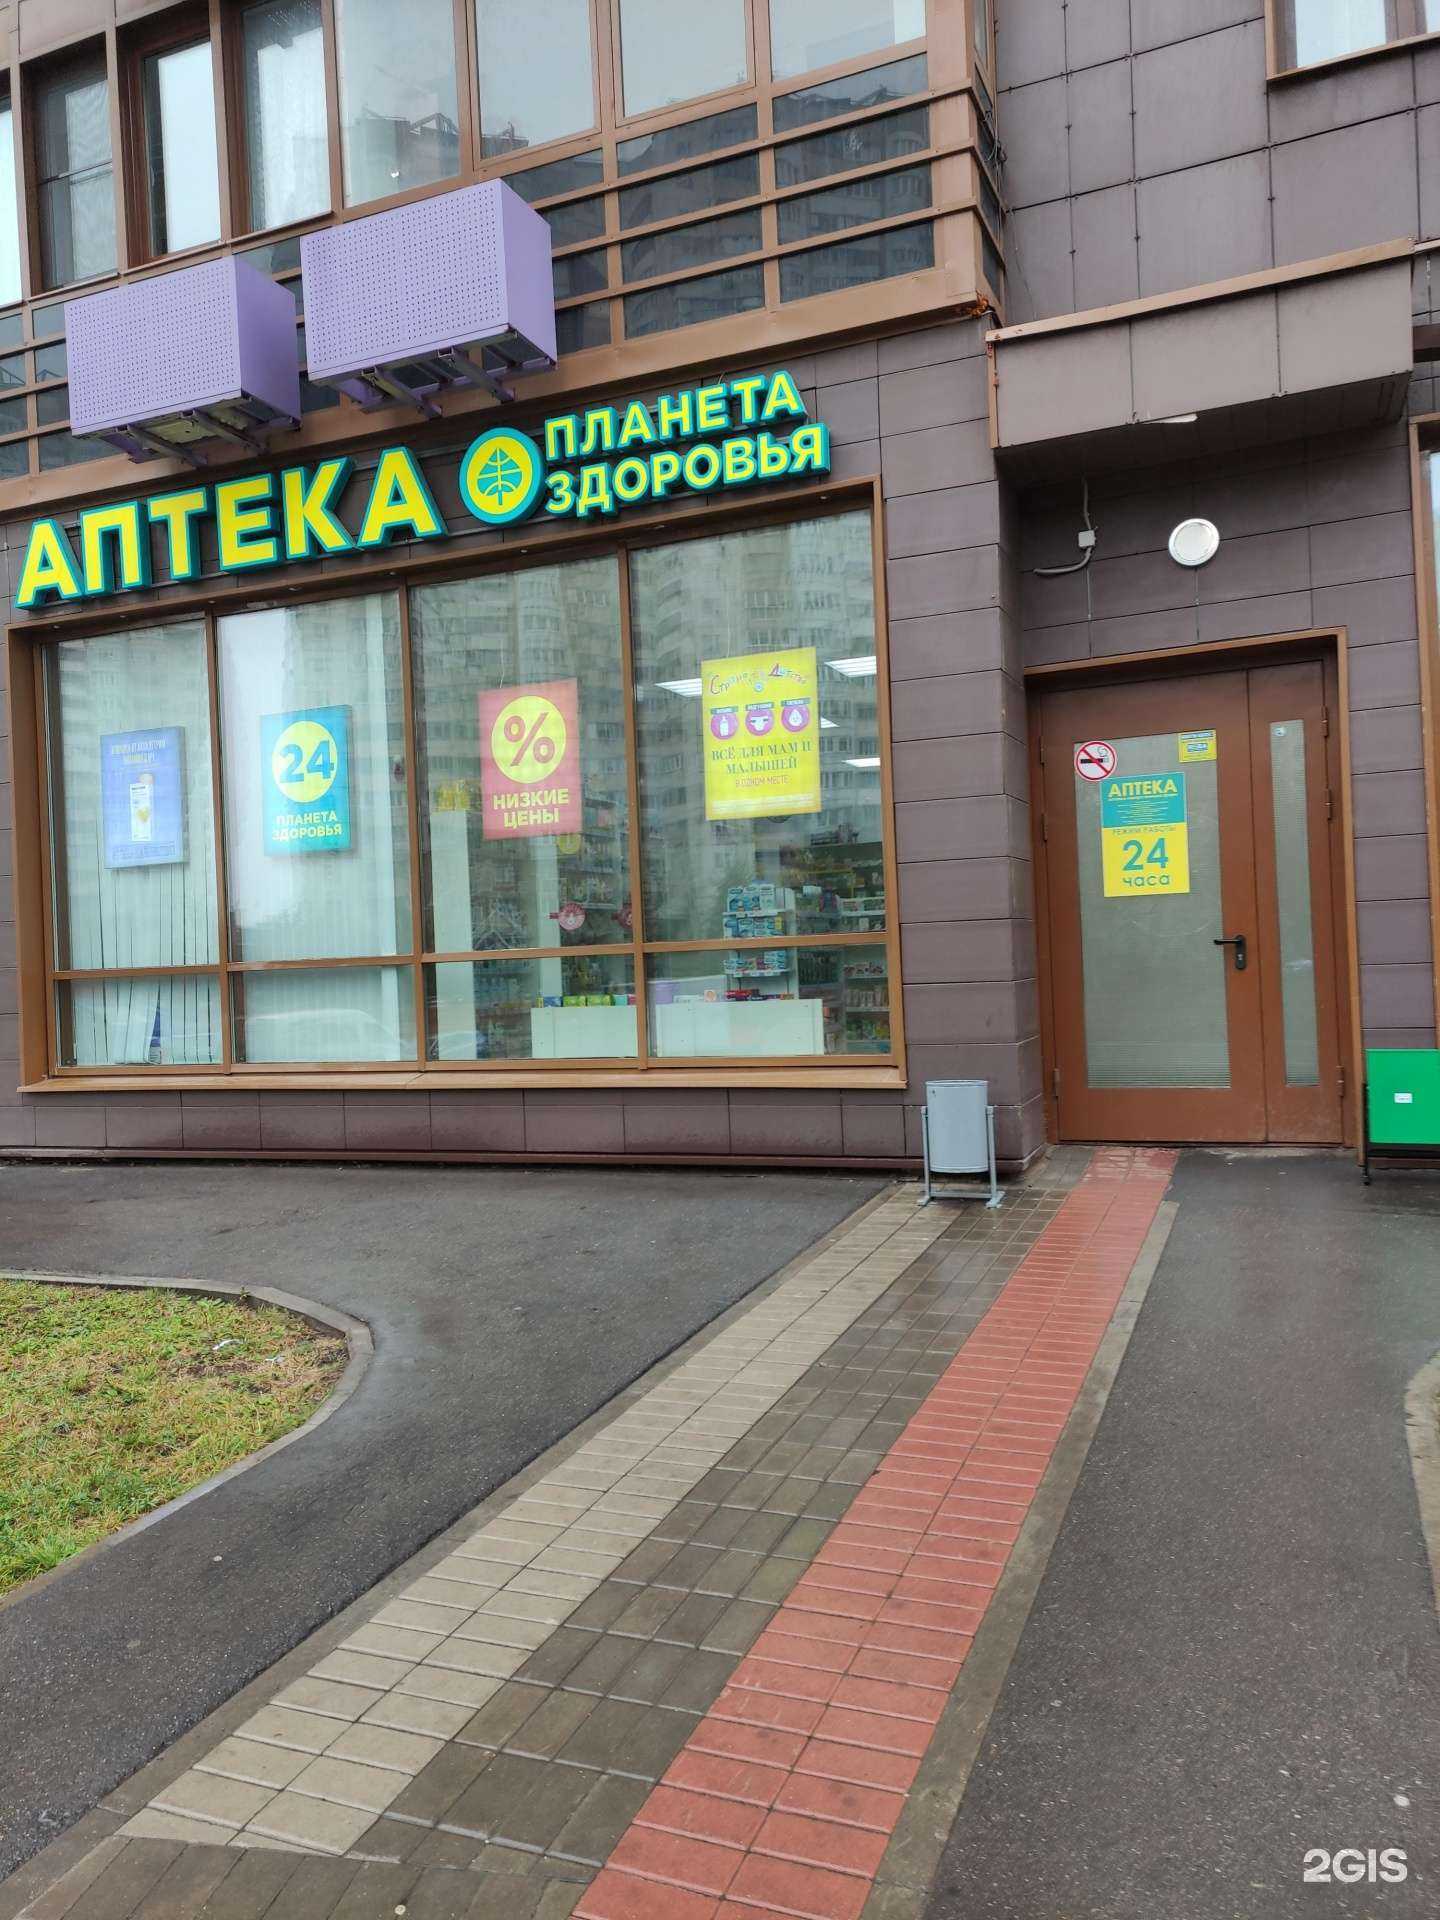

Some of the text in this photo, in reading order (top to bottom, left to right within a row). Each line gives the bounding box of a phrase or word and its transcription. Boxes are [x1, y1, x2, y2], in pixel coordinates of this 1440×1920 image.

[545, 370, 808, 462] ПЛАНЕТА
[544, 422, 831, 519] ЗДОРОВЬЯ
[15, 446, 447, 610] АПТЕКА
[767, 742, 798, 756] МАМ
[279, 739, 335, 784] 24
[493, 788, 569, 810] НИЗКИЕ
[1108, 779, 1178, 798] АПТЕКА
[276, 810, 338, 826] ПЛАНЕТА
[504, 808, 560, 829] ЦЕНЫ
[272, 823, 343, 842] ЗДОРОВЬЯ
[1122, 838, 1169, 871] 24
[1122, 875, 1170, 887] часа
